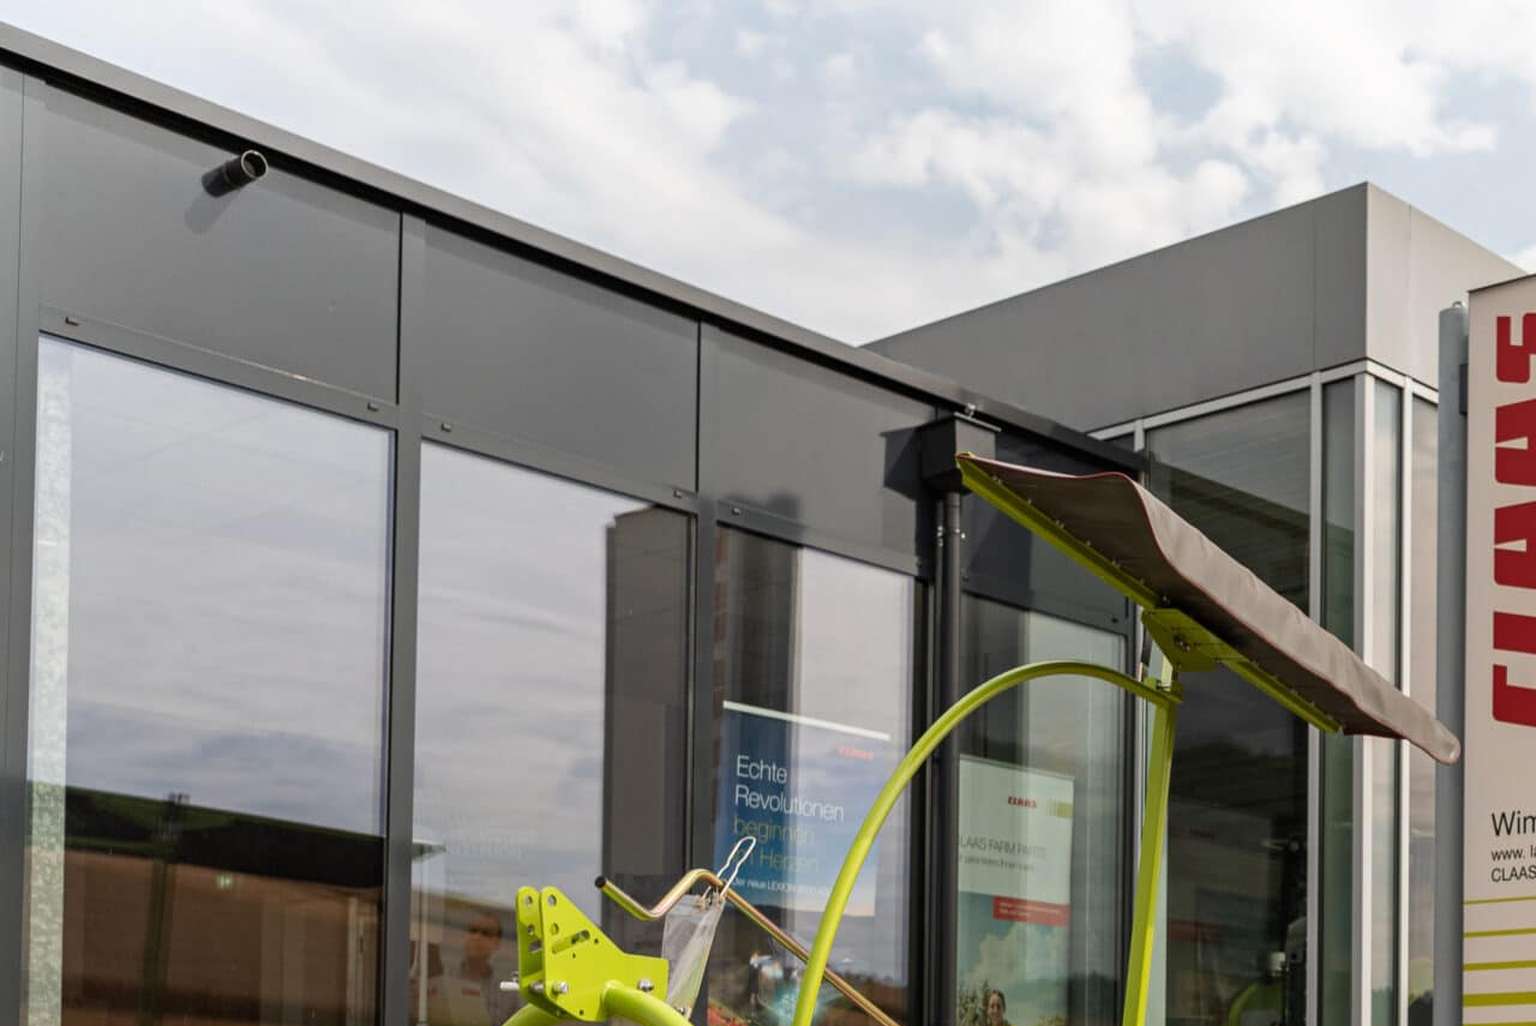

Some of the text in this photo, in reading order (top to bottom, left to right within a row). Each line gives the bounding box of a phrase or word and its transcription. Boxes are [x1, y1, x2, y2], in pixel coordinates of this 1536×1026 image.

[736, 754, 788, 784] Echte
[735, 784, 845, 822] Revolutionen
[960, 834, 986, 850] LAAS
[1490, 864, 1536, 882] CLAAS
